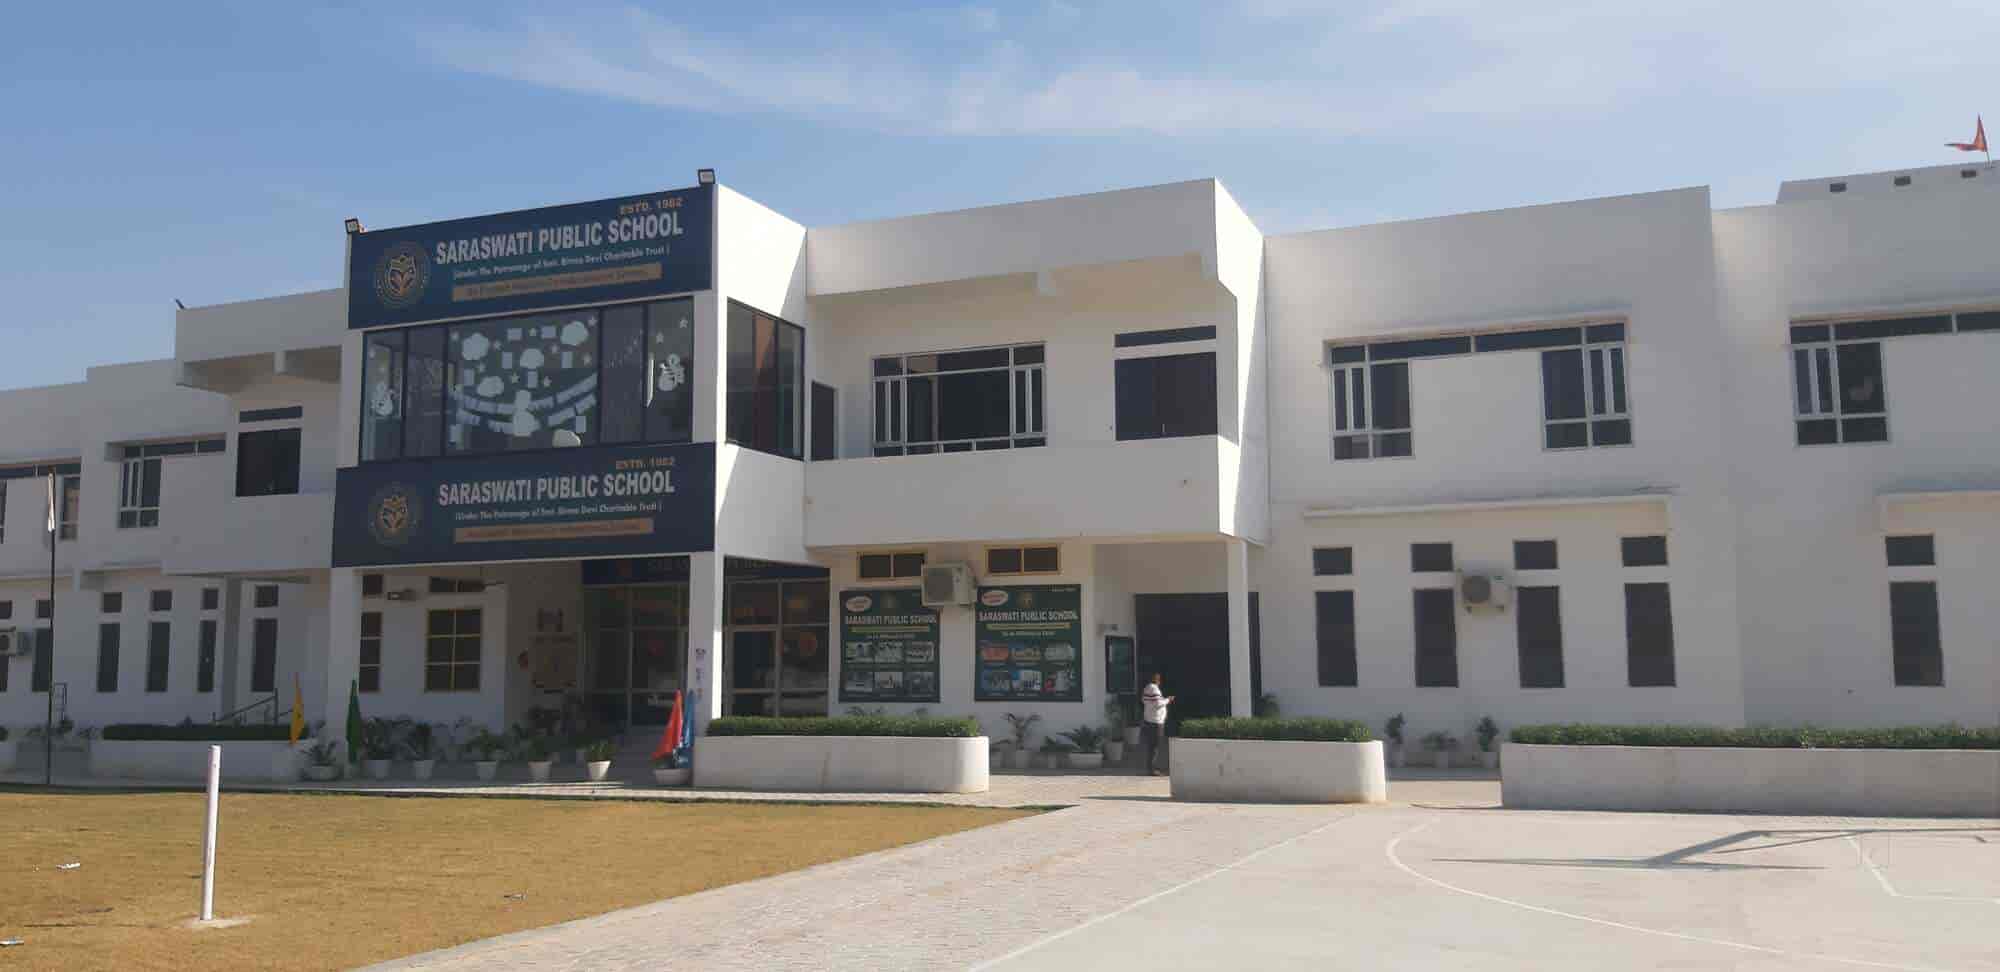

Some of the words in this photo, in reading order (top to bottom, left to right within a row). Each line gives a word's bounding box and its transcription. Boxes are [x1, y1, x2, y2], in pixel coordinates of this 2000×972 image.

[436, 231, 533, 265] SARASWATI
[538, 221, 603, 253] PUBLIC
[607, 211, 683, 244] SCHOOL
[439, 479, 532, 506] SARASWATI
[537, 474, 599, 501] PUBLIC
[603, 470, 675, 497] SCHOOL
[883, 615, 909, 625] PUBLIC
[910, 614, 937, 625] SCHOOL
[979, 610, 1018, 622] SARASWATI
[1021, 609, 1047, 621] PUBLIC
[1049, 608, 1079, 621] SCHOOL
